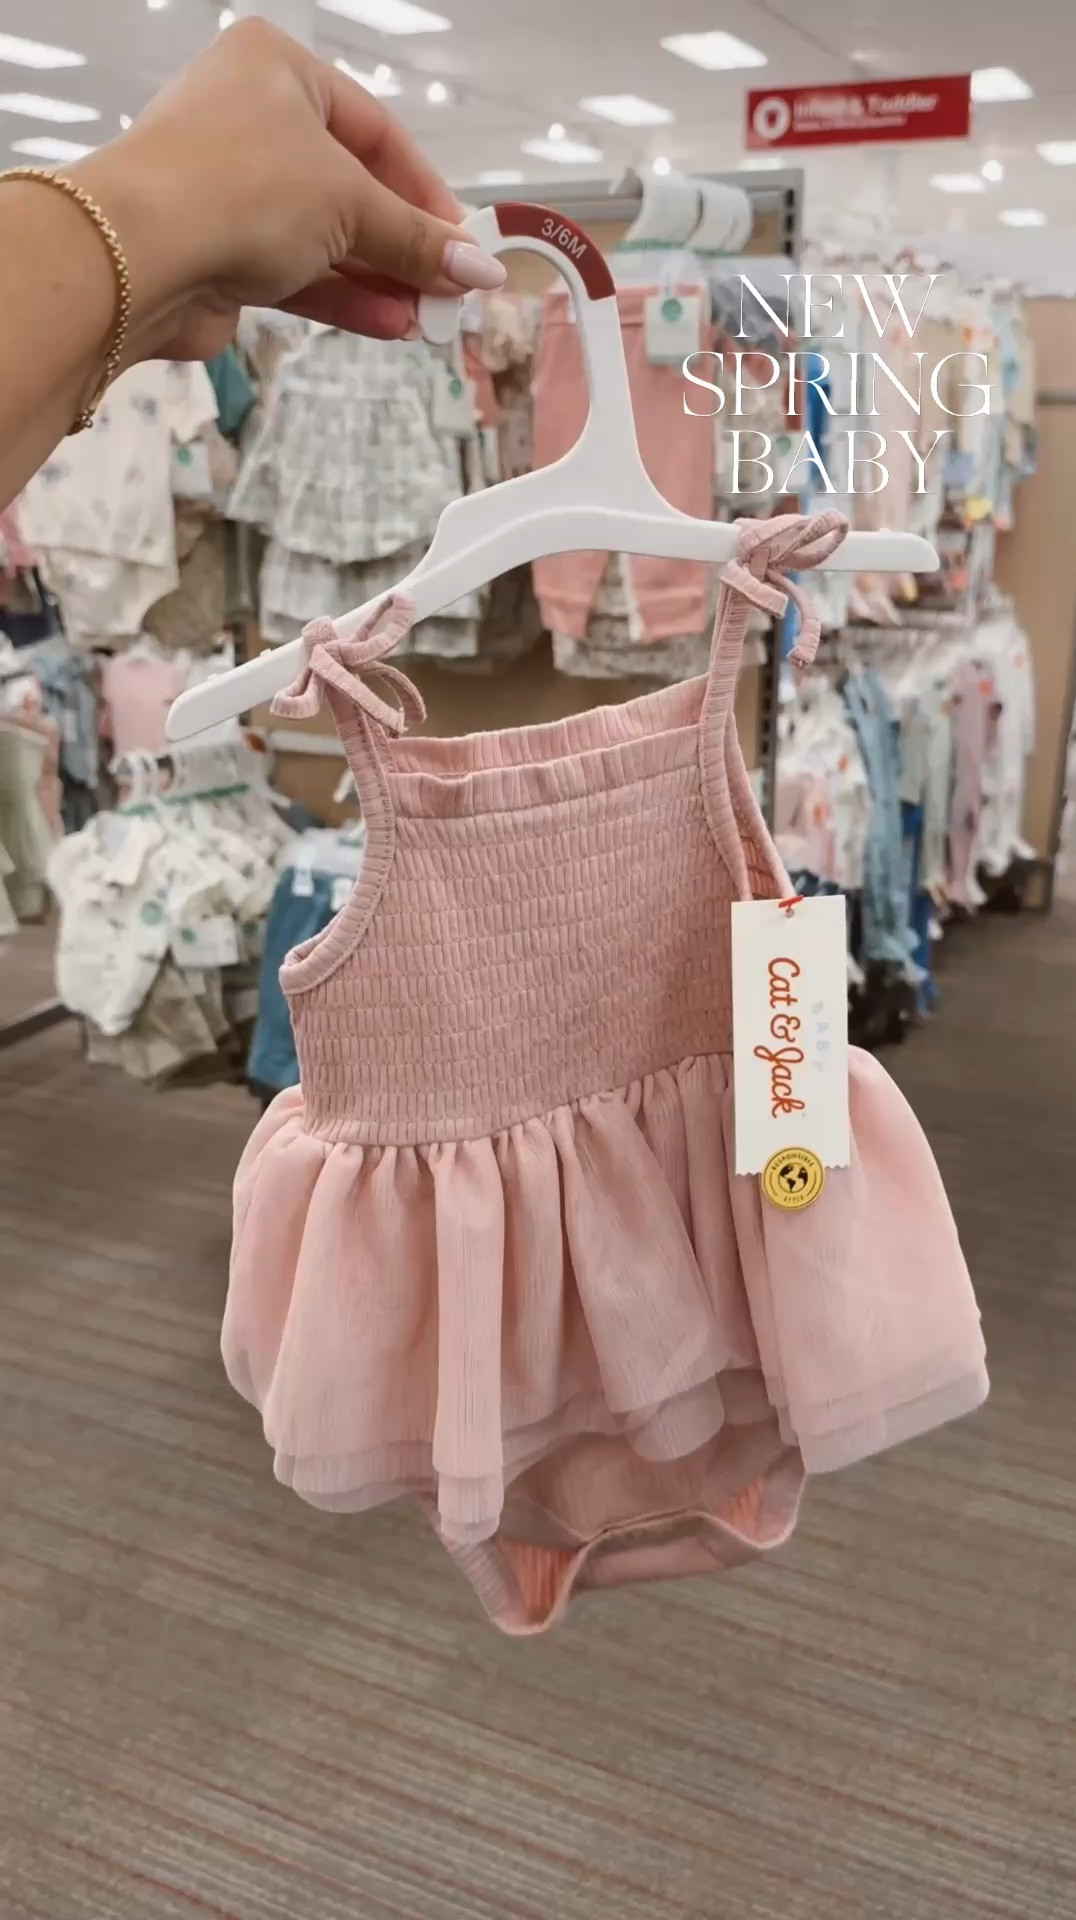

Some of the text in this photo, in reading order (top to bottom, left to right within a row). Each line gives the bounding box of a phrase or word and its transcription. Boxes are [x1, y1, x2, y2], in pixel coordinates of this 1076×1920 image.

[541, 218, 587, 259] 3/6M
[753, 957, 806, 1119] Cat & Jack
